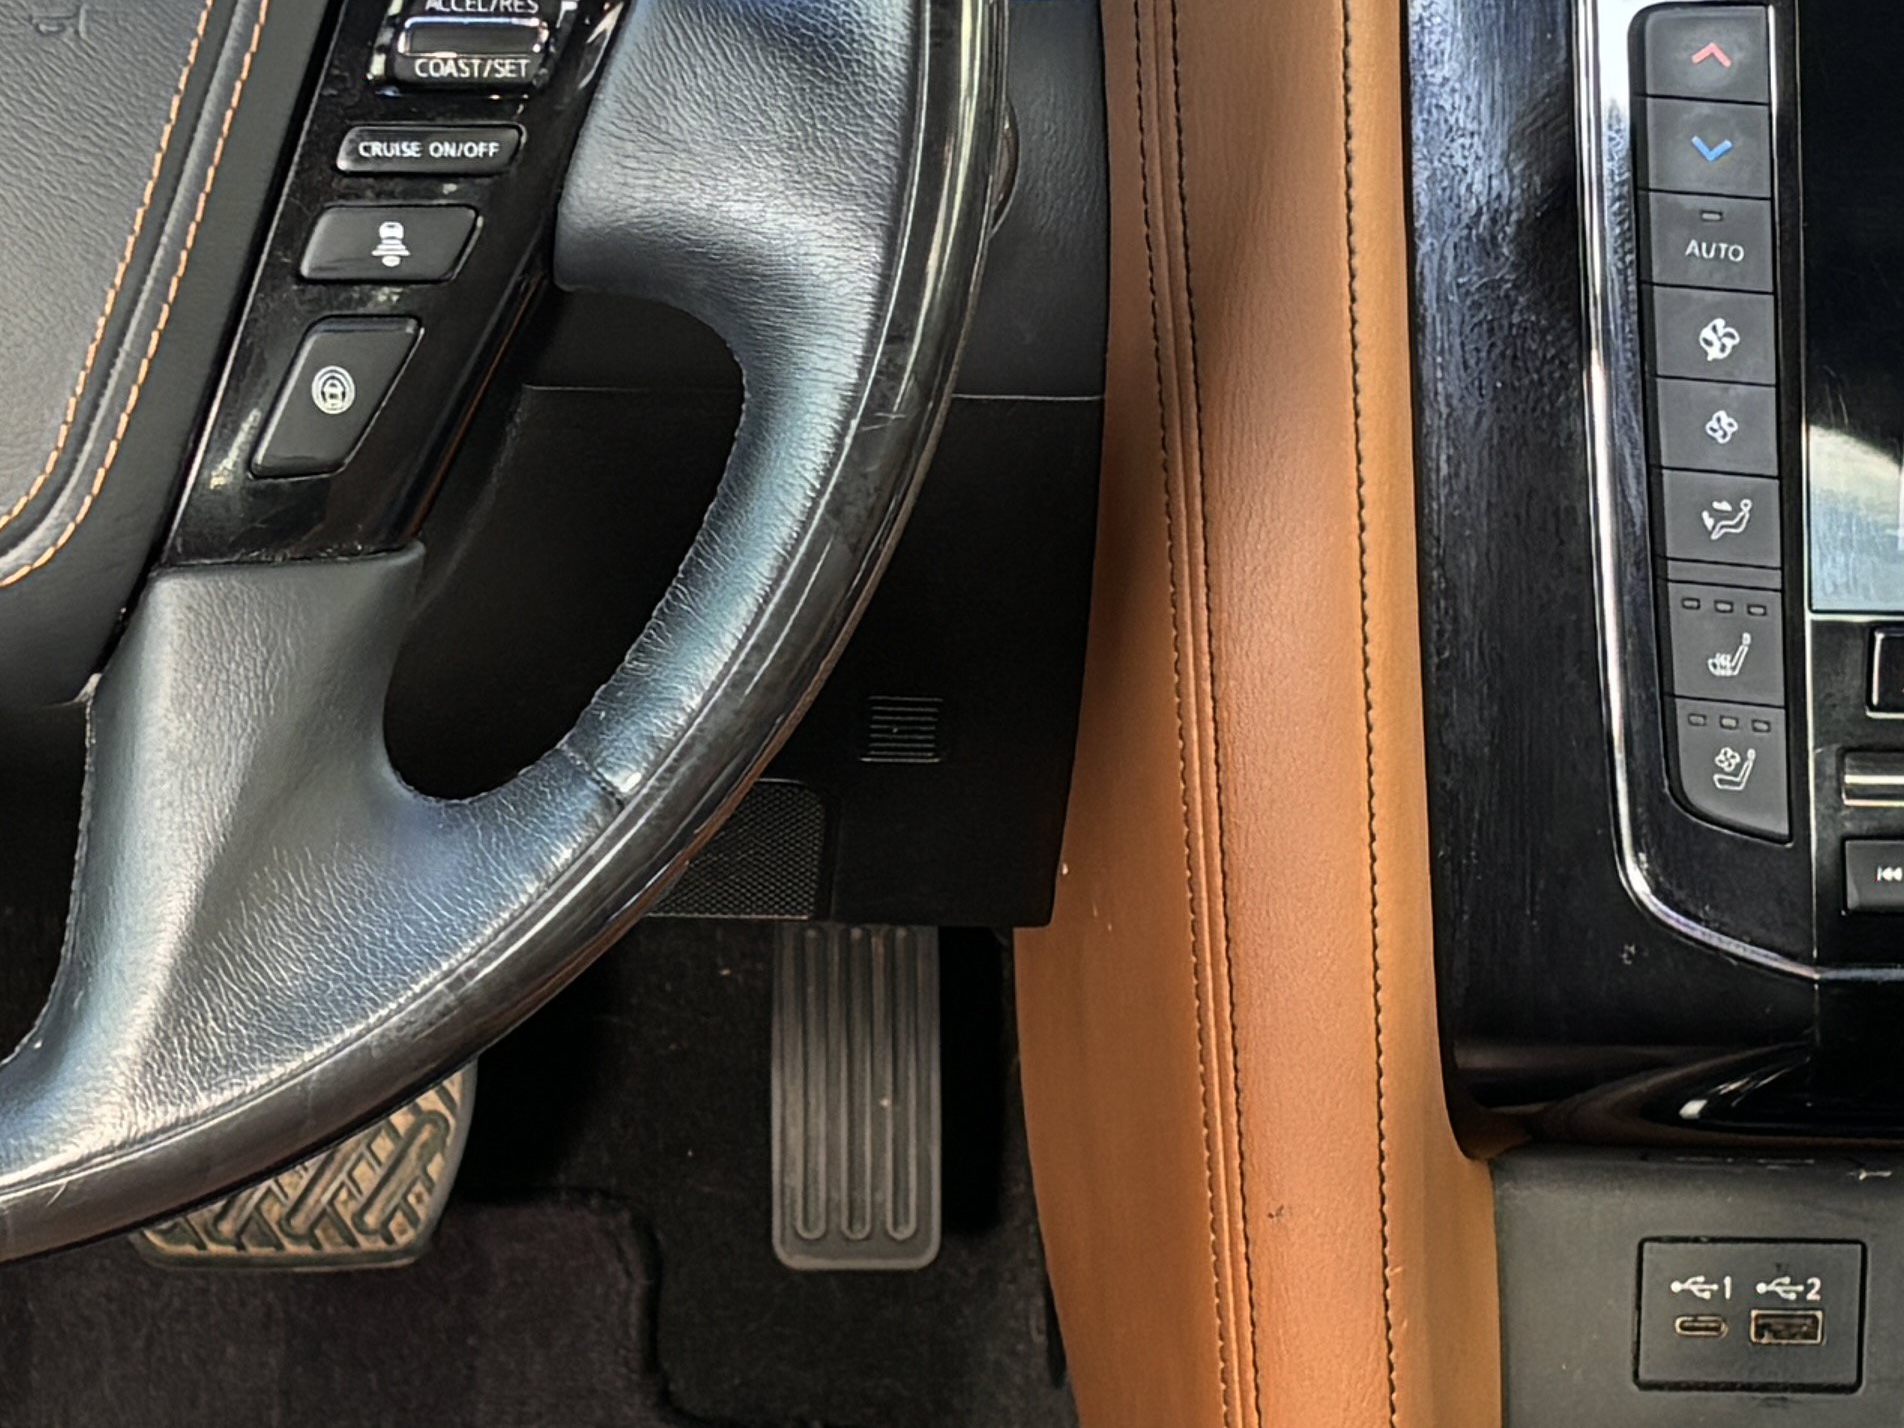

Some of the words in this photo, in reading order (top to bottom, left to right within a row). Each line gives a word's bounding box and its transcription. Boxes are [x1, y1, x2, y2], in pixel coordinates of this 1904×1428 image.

[414, 58, 530, 79] COAST/SET
[357, 141, 422, 159] CRUISE
[429, 141, 501, 159] ON/OFF
[1684, 239, 1746, 263] AUTO
[1722, 1276, 1733, 1301] 1
[1805, 1277, 1822, 1302] 2
